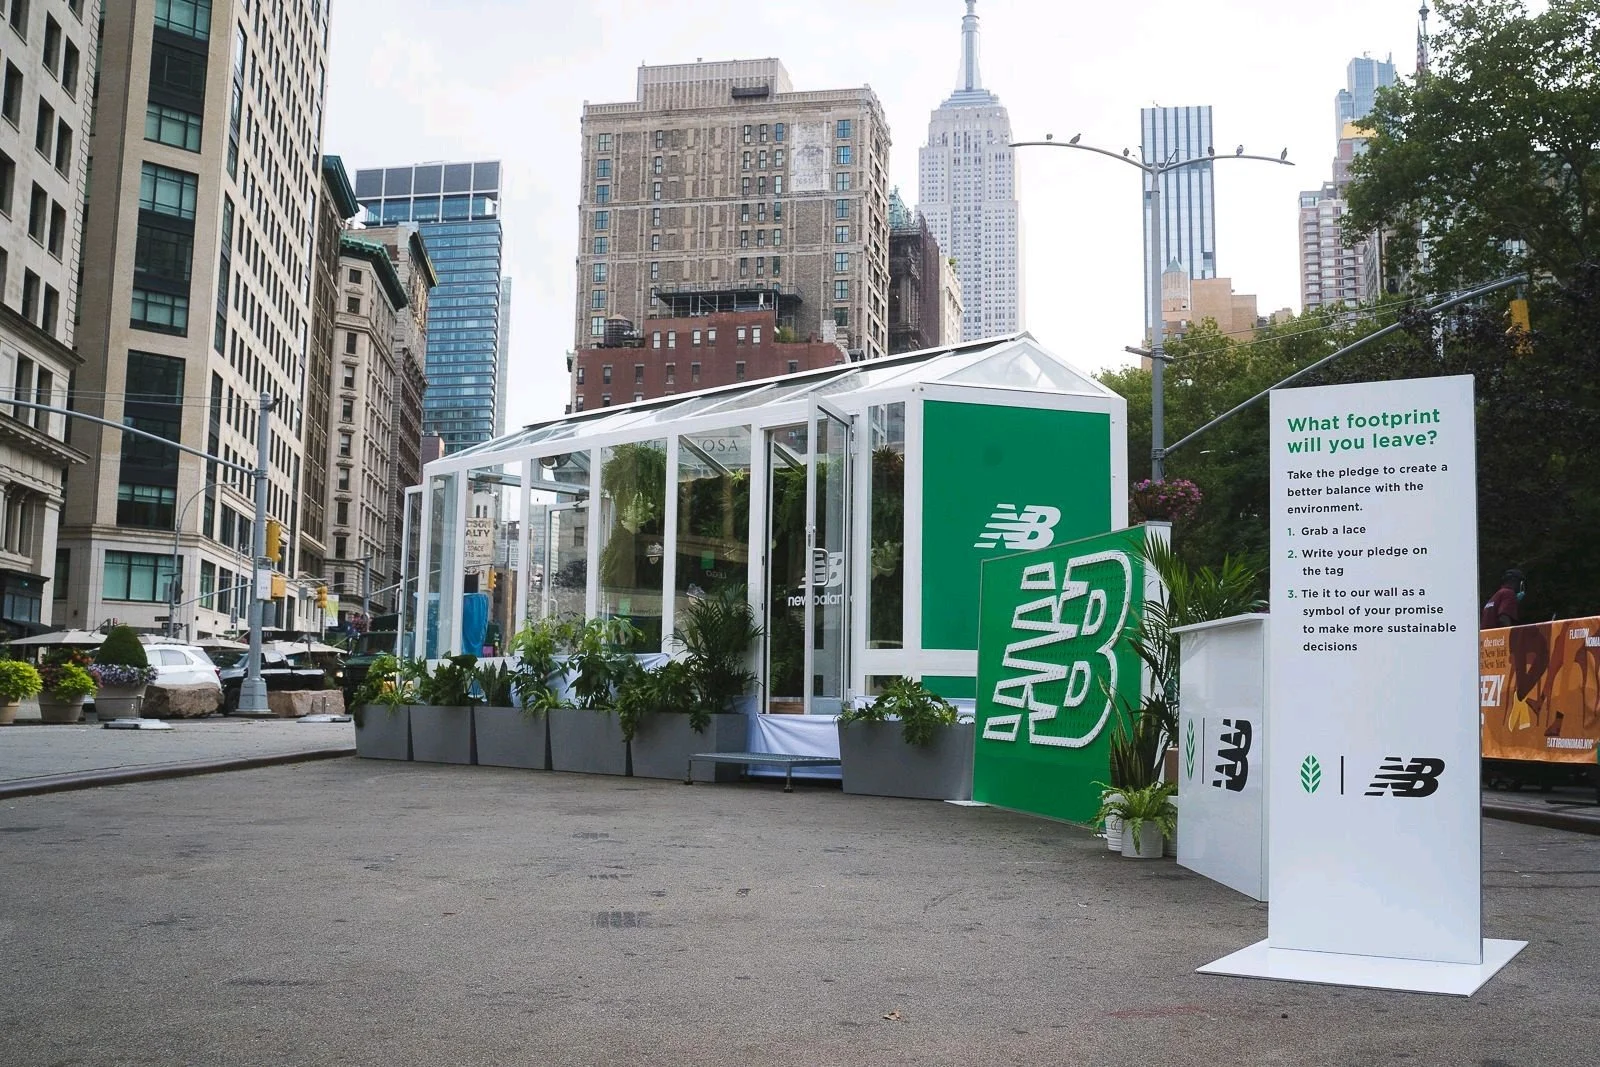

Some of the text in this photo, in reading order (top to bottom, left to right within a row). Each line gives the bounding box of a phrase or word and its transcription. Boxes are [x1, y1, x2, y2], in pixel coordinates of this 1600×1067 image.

[1288, 409, 1440, 433] What footprint
[1287, 430, 1437, 454] will you leave?
[1287, 464, 1448, 479] Take the pledge to create a
[1287, 481, 1424, 496] better balance with the
[1287, 502, 1363, 514] environment.
[1287, 528, 1296, 537] 1.
[1301, 526, 1329, 536] Grab
[1343, 525, 1366, 534] lace
[1287, 546, 1428, 559] 2. Write your pledge on
[1303, 566, 1344, 576] the tag
[1287, 587, 1426, 599] 3. Tie it to our wall as a
[1303, 605, 1444, 617] symbol of your promise
[1303, 623, 1457, 634] to make more sustainable
[1303, 642, 1357, 652] decisions
